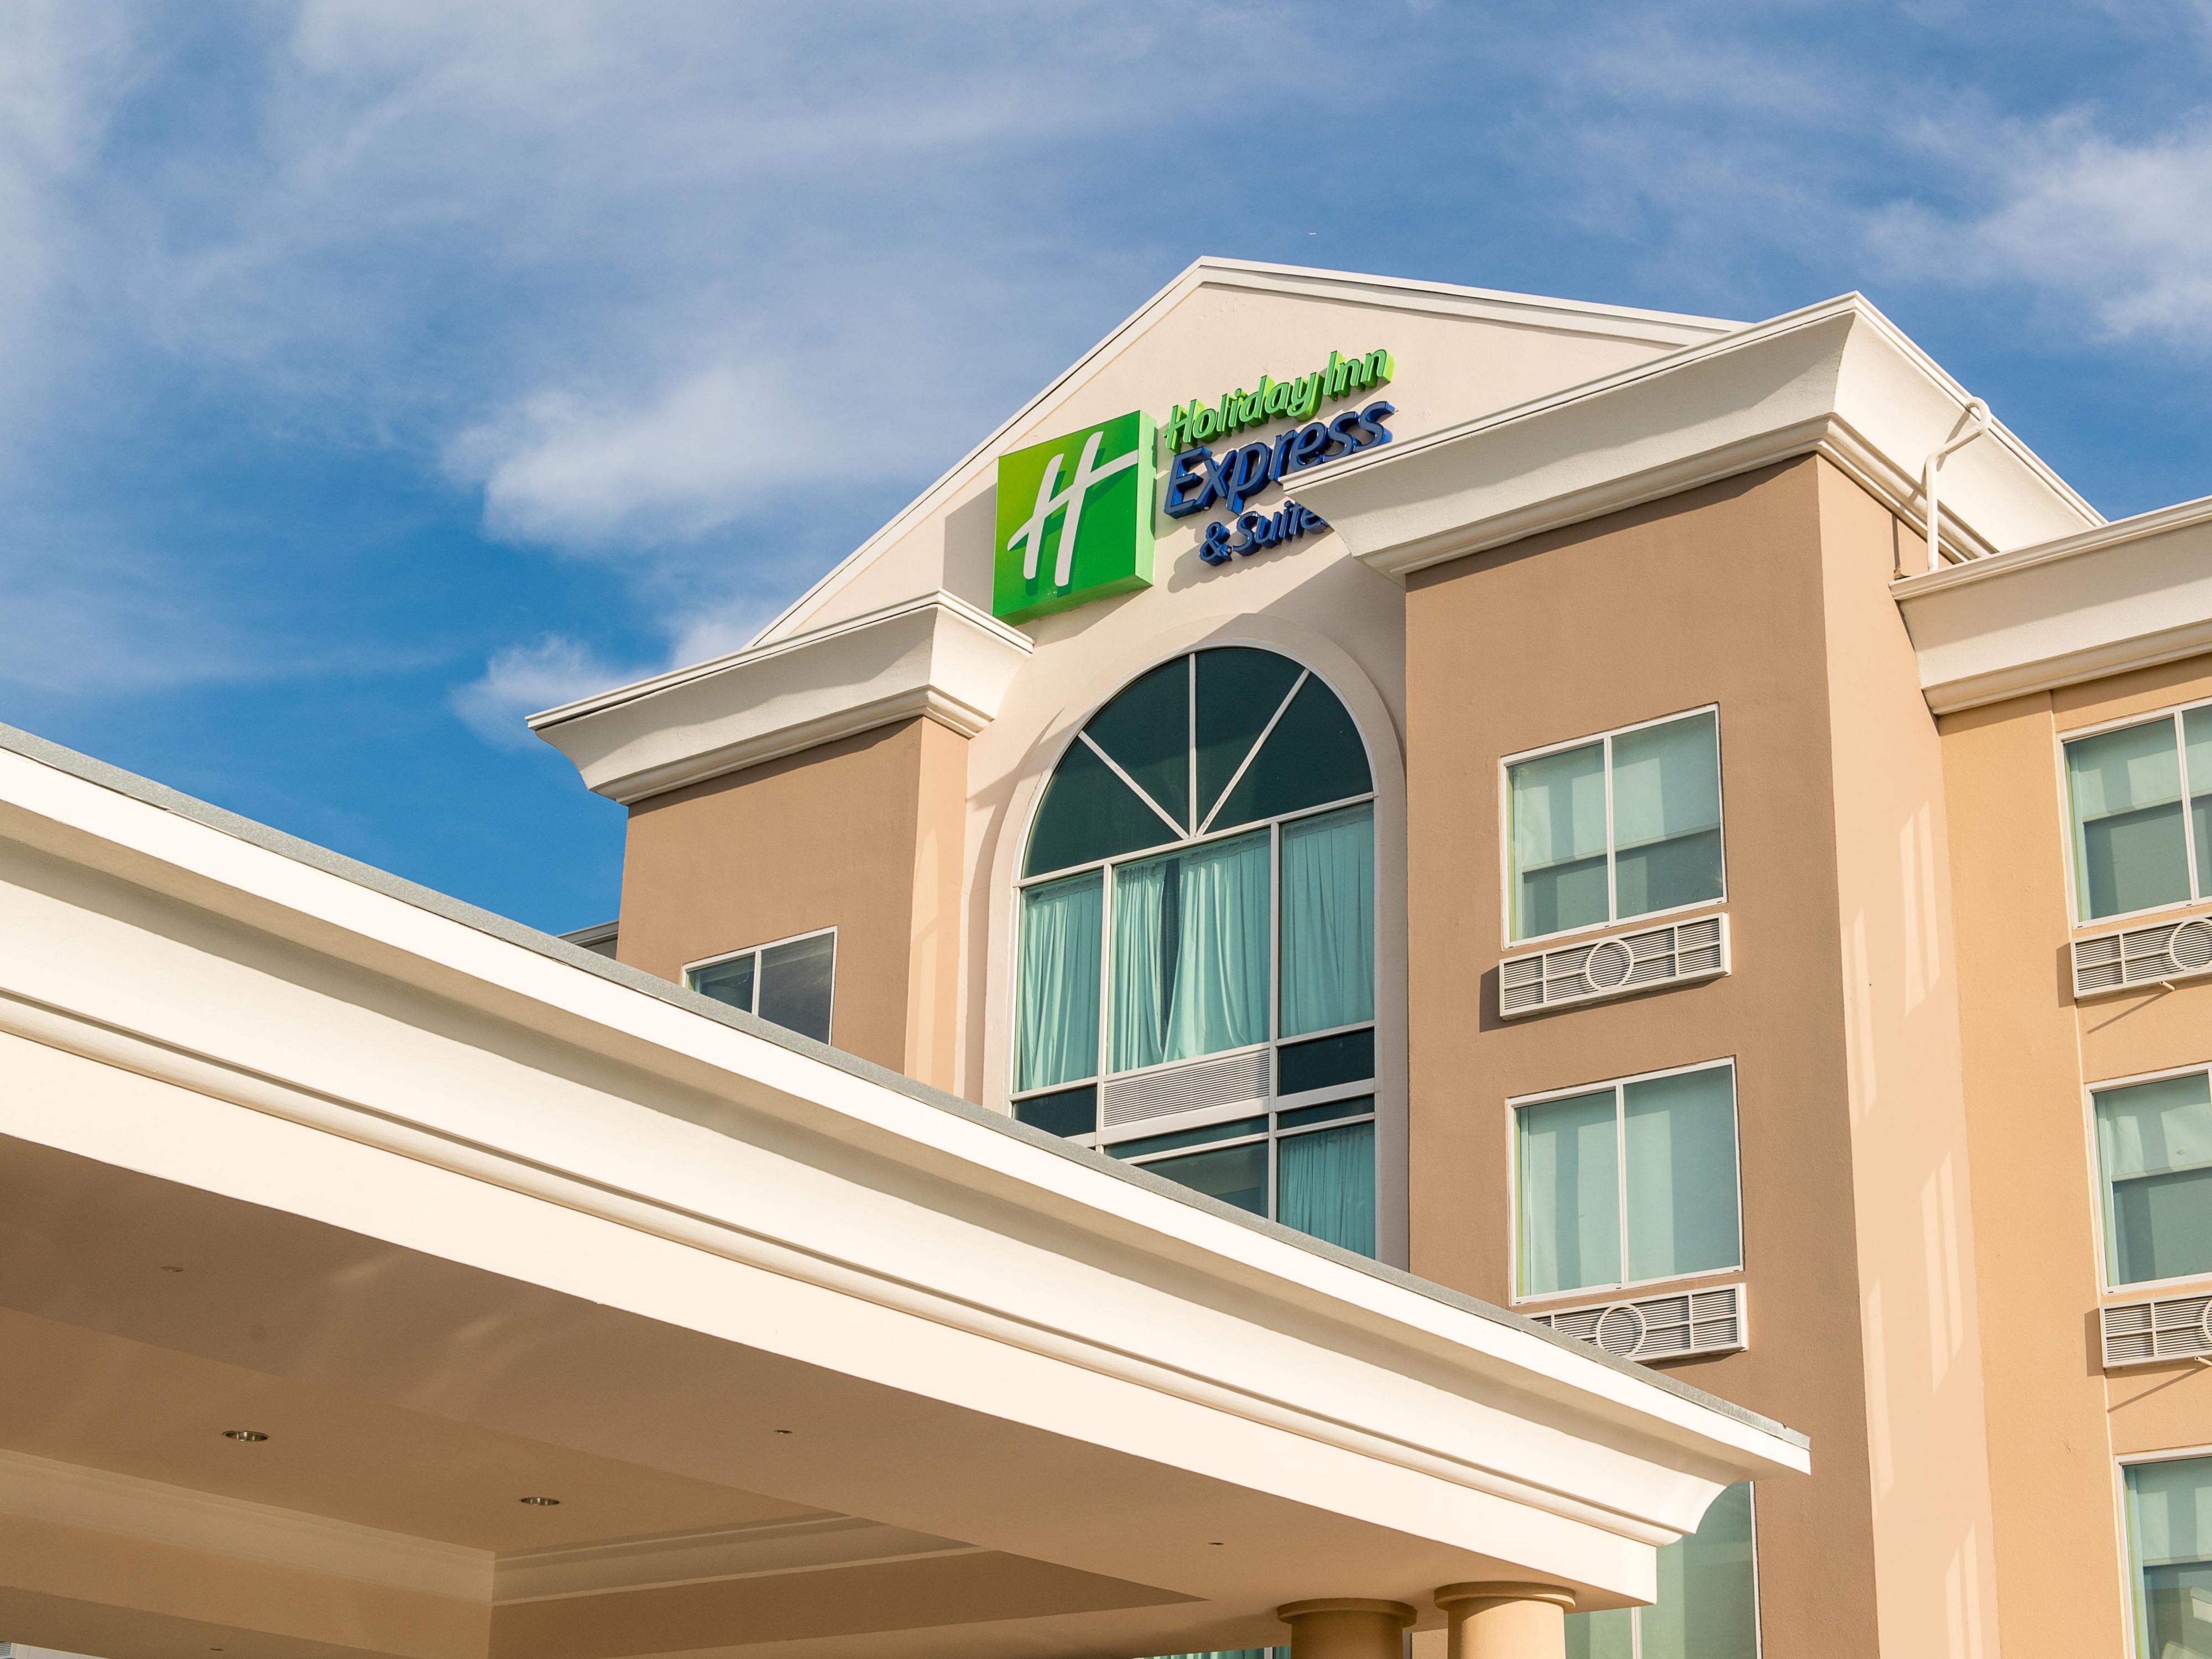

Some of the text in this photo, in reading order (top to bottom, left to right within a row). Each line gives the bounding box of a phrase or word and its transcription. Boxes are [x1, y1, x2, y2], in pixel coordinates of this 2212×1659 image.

[1163, 349, 1395, 453] Holiday Inn
[1007, 430, 1139, 587] H
[1164, 401, 1396, 519] Express
[1199, 500, 1329, 566] & Suite
